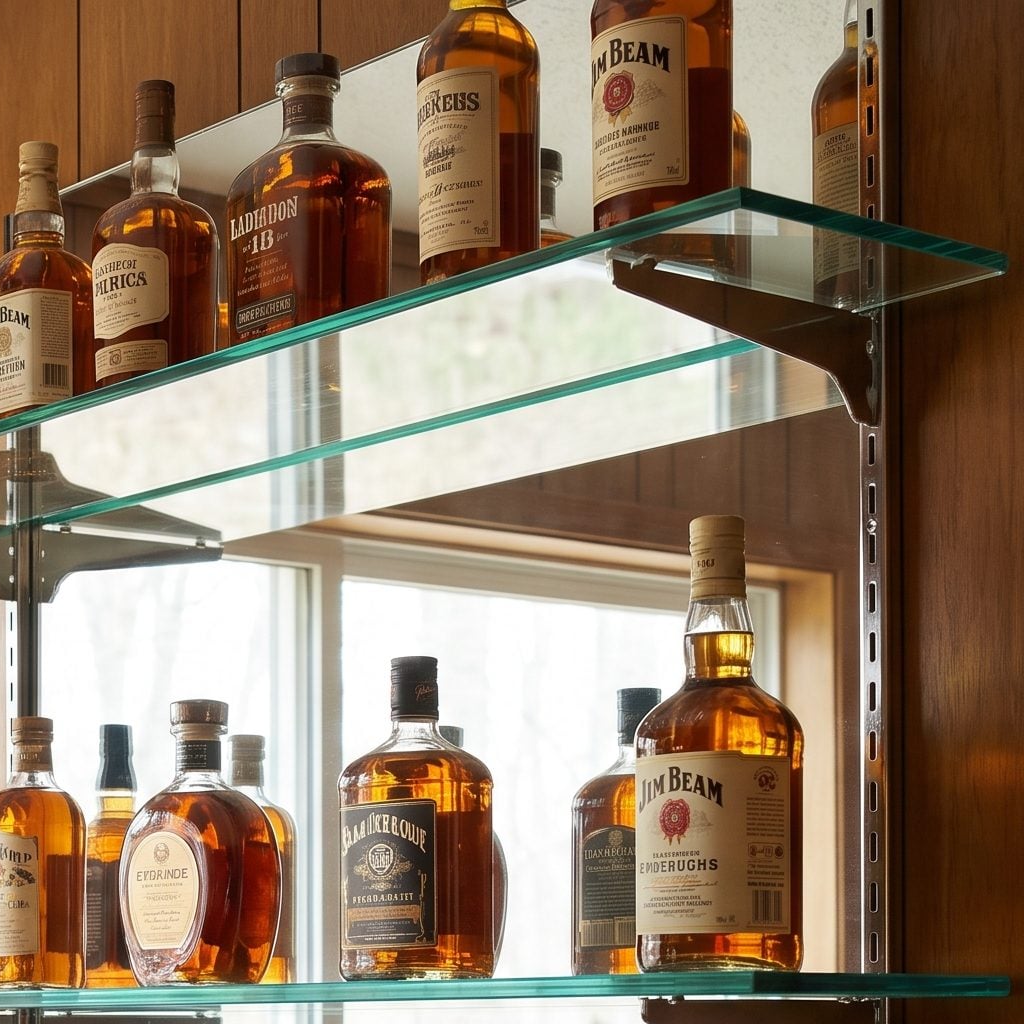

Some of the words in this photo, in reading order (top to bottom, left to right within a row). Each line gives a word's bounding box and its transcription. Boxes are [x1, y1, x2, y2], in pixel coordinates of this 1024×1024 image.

[609, 38, 671, 73] BEAM
[0, 306, 31, 330] BEAM
[639, 773, 666, 814] JIM
[668, 766, 724, 808] BEAM
